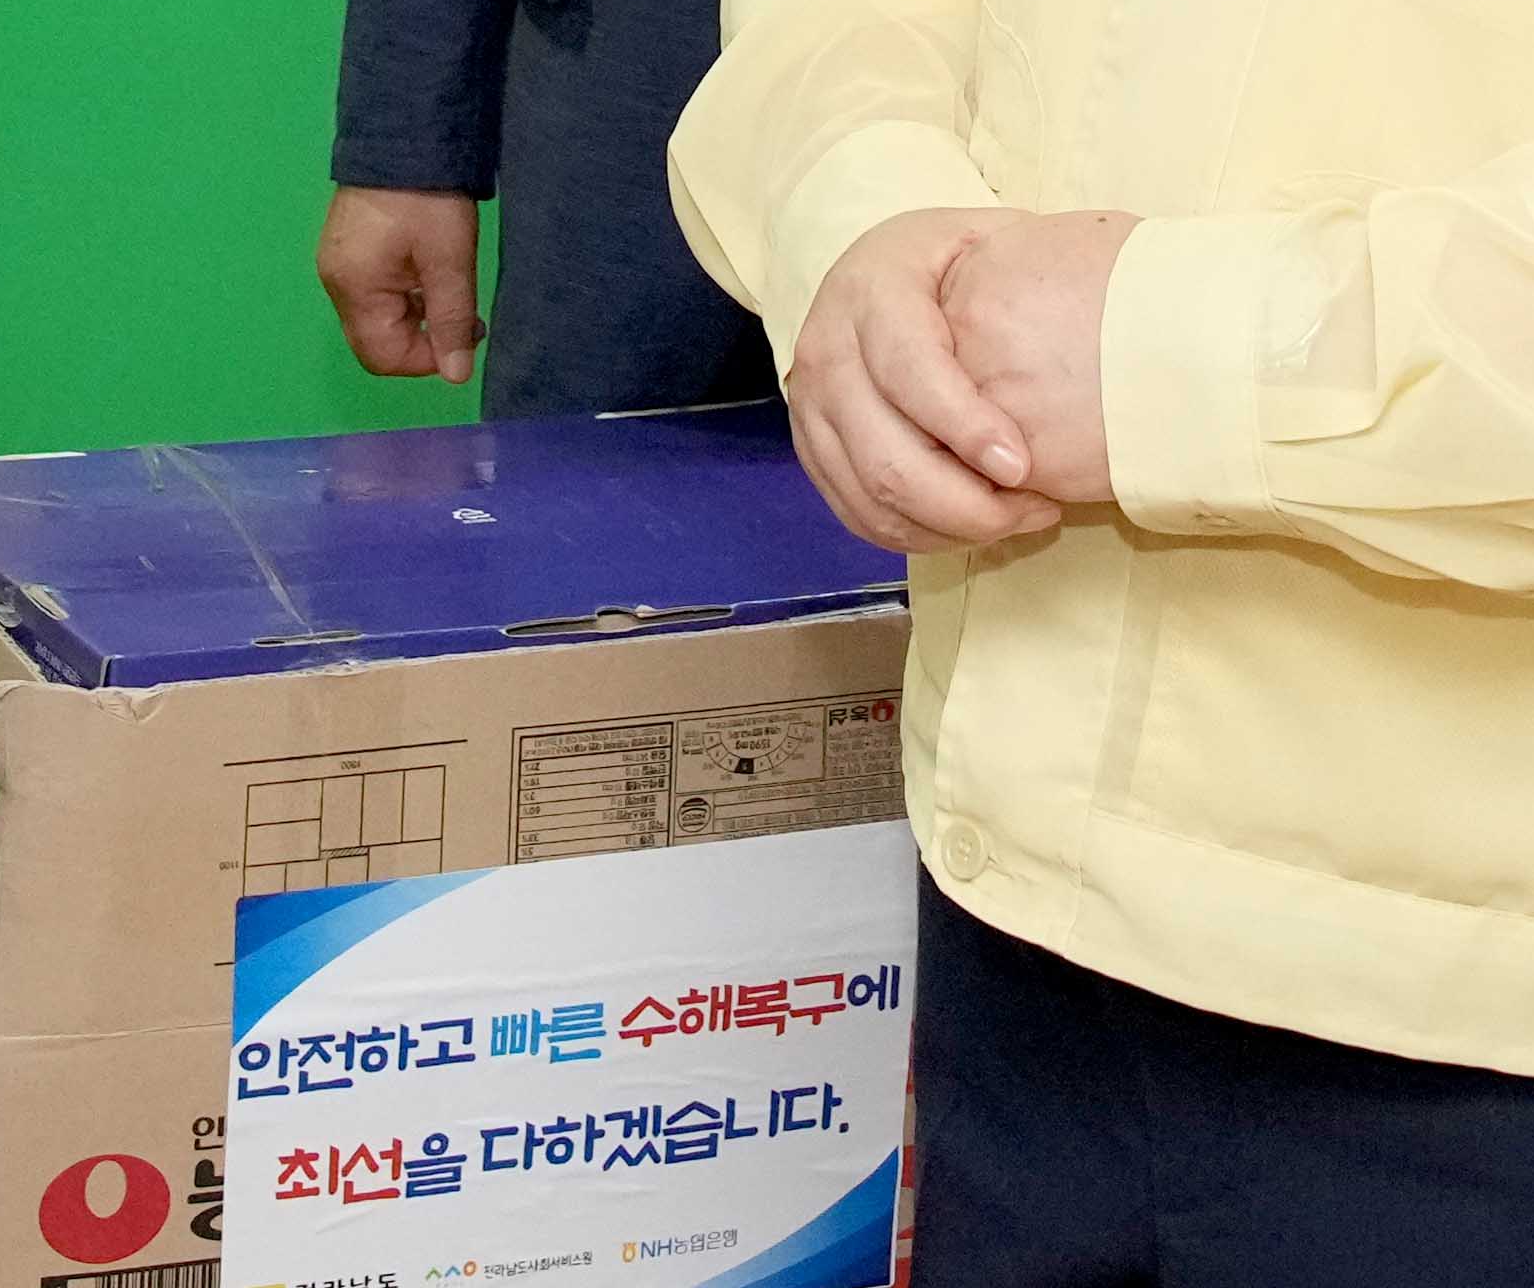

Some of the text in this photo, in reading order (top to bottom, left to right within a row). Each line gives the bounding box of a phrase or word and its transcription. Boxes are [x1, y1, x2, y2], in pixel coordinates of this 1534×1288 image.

[237, 965, 901, 1100] 안전하고 빠른 수해복구에
[275, 1133, 467, 1204] 최선을
[481, 1082, 849, 1172] 다하겠습니다.
[640, 1228, 739, 1260] NH농협은행
